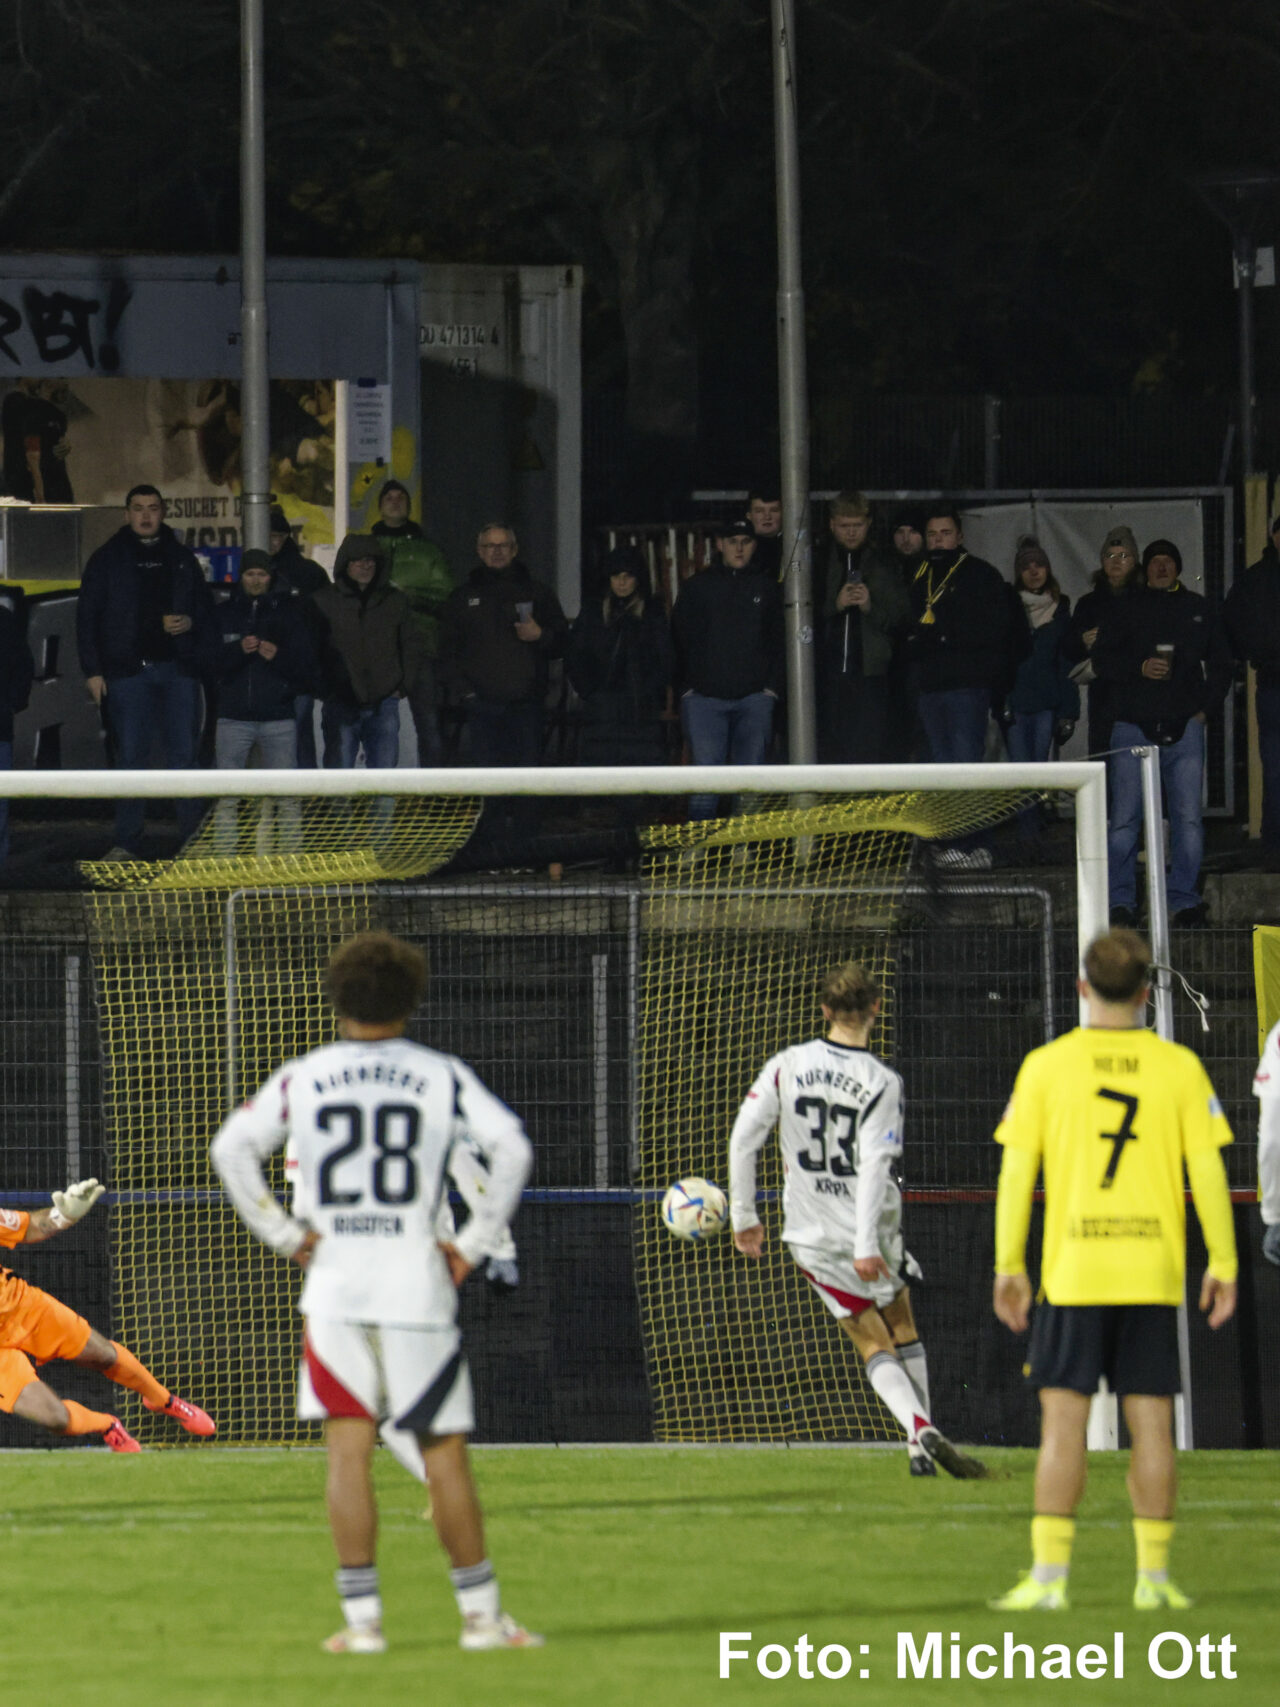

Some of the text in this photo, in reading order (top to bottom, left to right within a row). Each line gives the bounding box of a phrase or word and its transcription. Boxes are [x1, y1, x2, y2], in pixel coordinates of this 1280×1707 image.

[440, 326, 484, 344] 471314
[491, 326, 499, 344] 4
[164, 497, 228, 518] ESUCHET
[316, 1103, 422, 1206] 28
[795, 1096, 859, 1176] 33
[1096, 1087, 1138, 1190] 7
